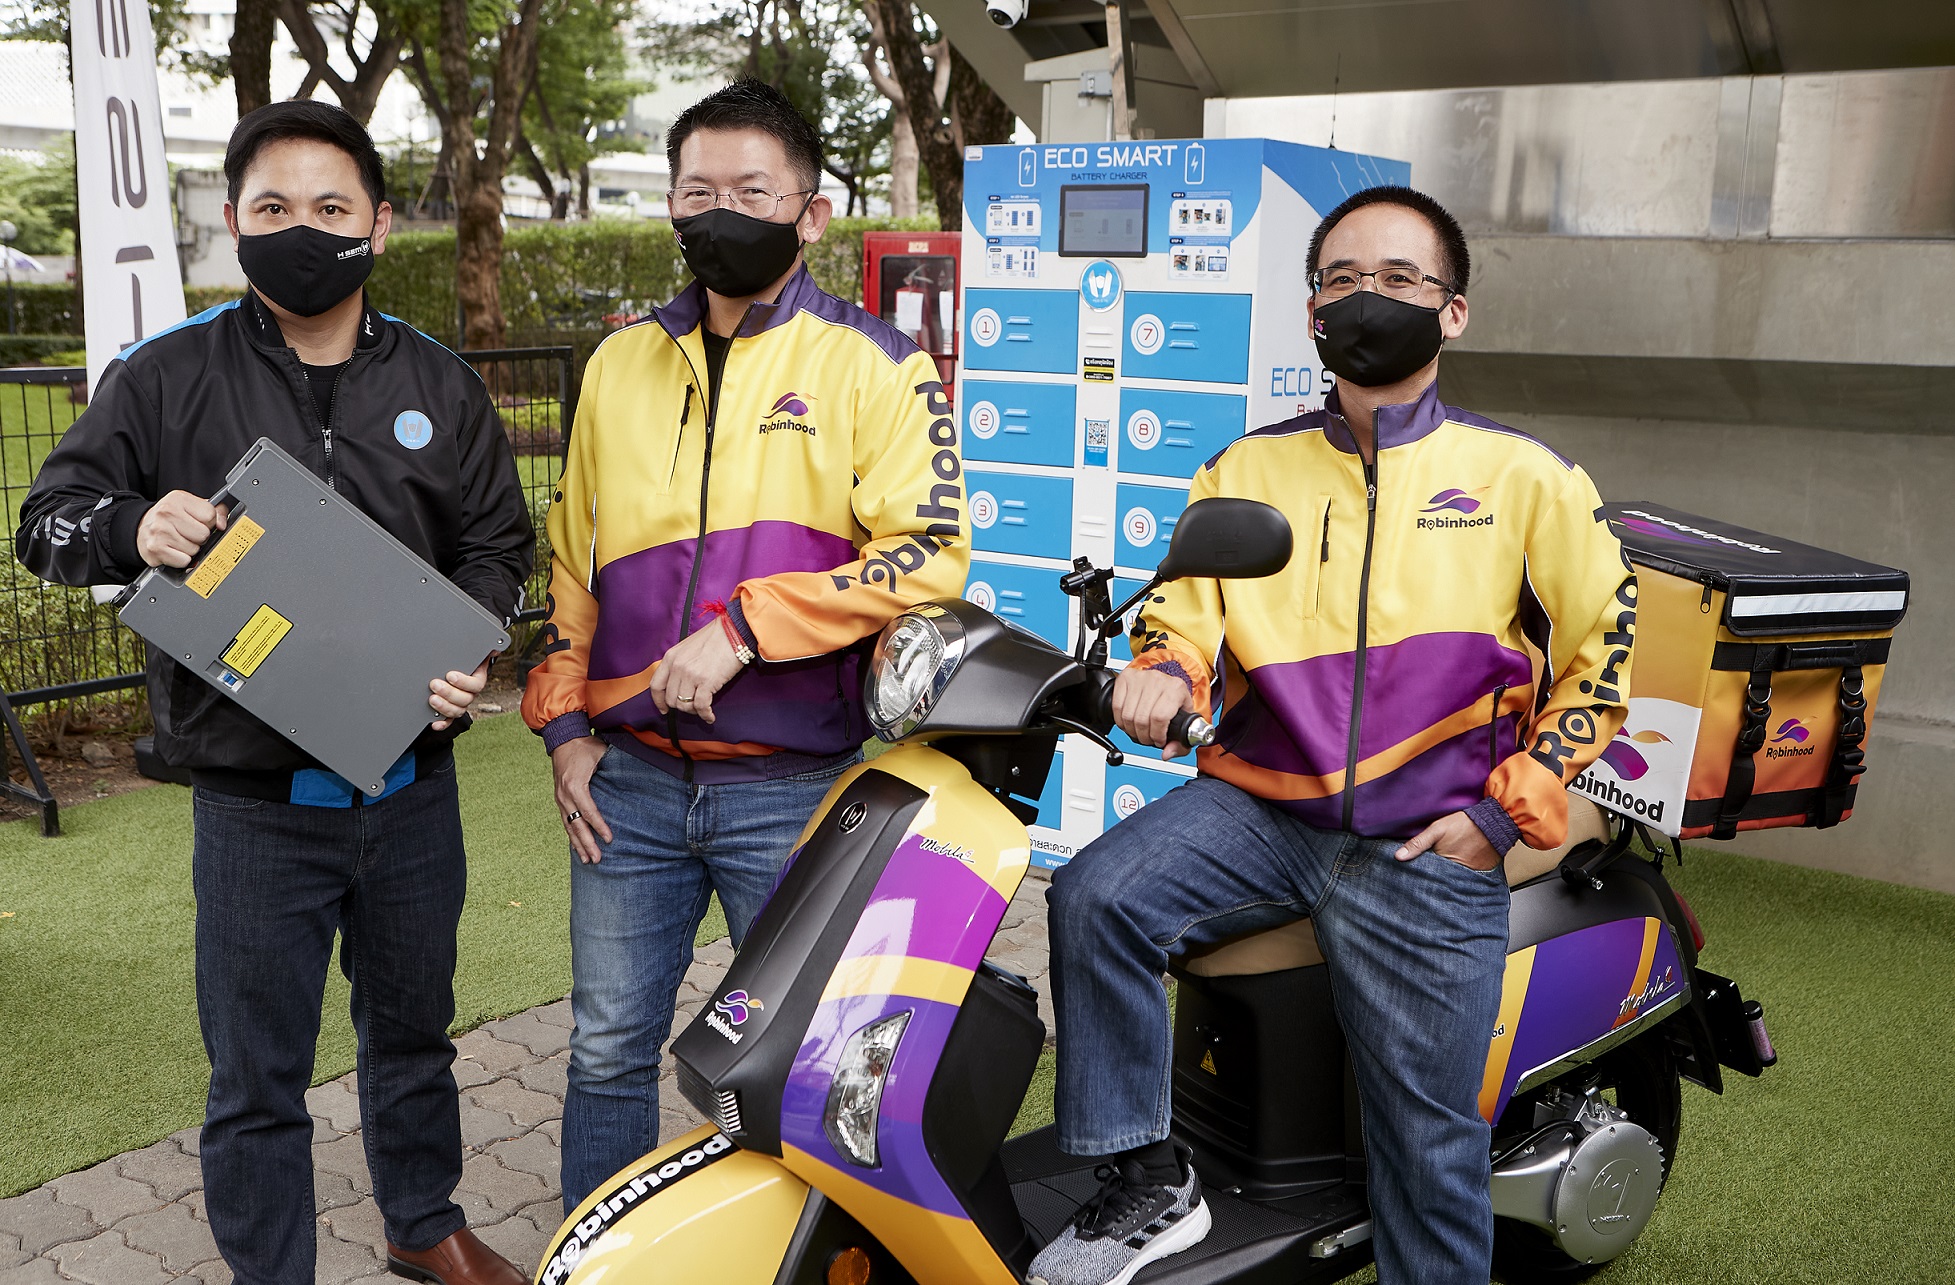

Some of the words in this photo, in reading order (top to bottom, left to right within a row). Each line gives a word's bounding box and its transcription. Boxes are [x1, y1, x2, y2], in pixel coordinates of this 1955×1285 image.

[1044, 148, 1088, 169] ECO
[1096, 145, 1178, 168] SMART
[1071, 172, 1107, 181] BATTERY
[1110, 171, 1148, 180] CHARGER
[982, 321, 990, 333] 1
[1143, 328, 1153, 341] 7
[1271, 367, 1312, 397] ECO
[980, 413, 989, 426] 2
[758, 419, 817, 437] Robinhood
[1138, 423, 1149, 436] 8
[978, 504, 987, 516] 3
[1134, 521, 1145, 534] 9
[1416, 513, 1494, 531] Robinhood
[976, 594, 985, 605] 4
[1765, 744, 1816, 761] Robinhood
[1571, 768, 1665, 823] binhood
[1121, 798, 1137, 811] 12
[704, 1010, 744, 1045] Robinhood
